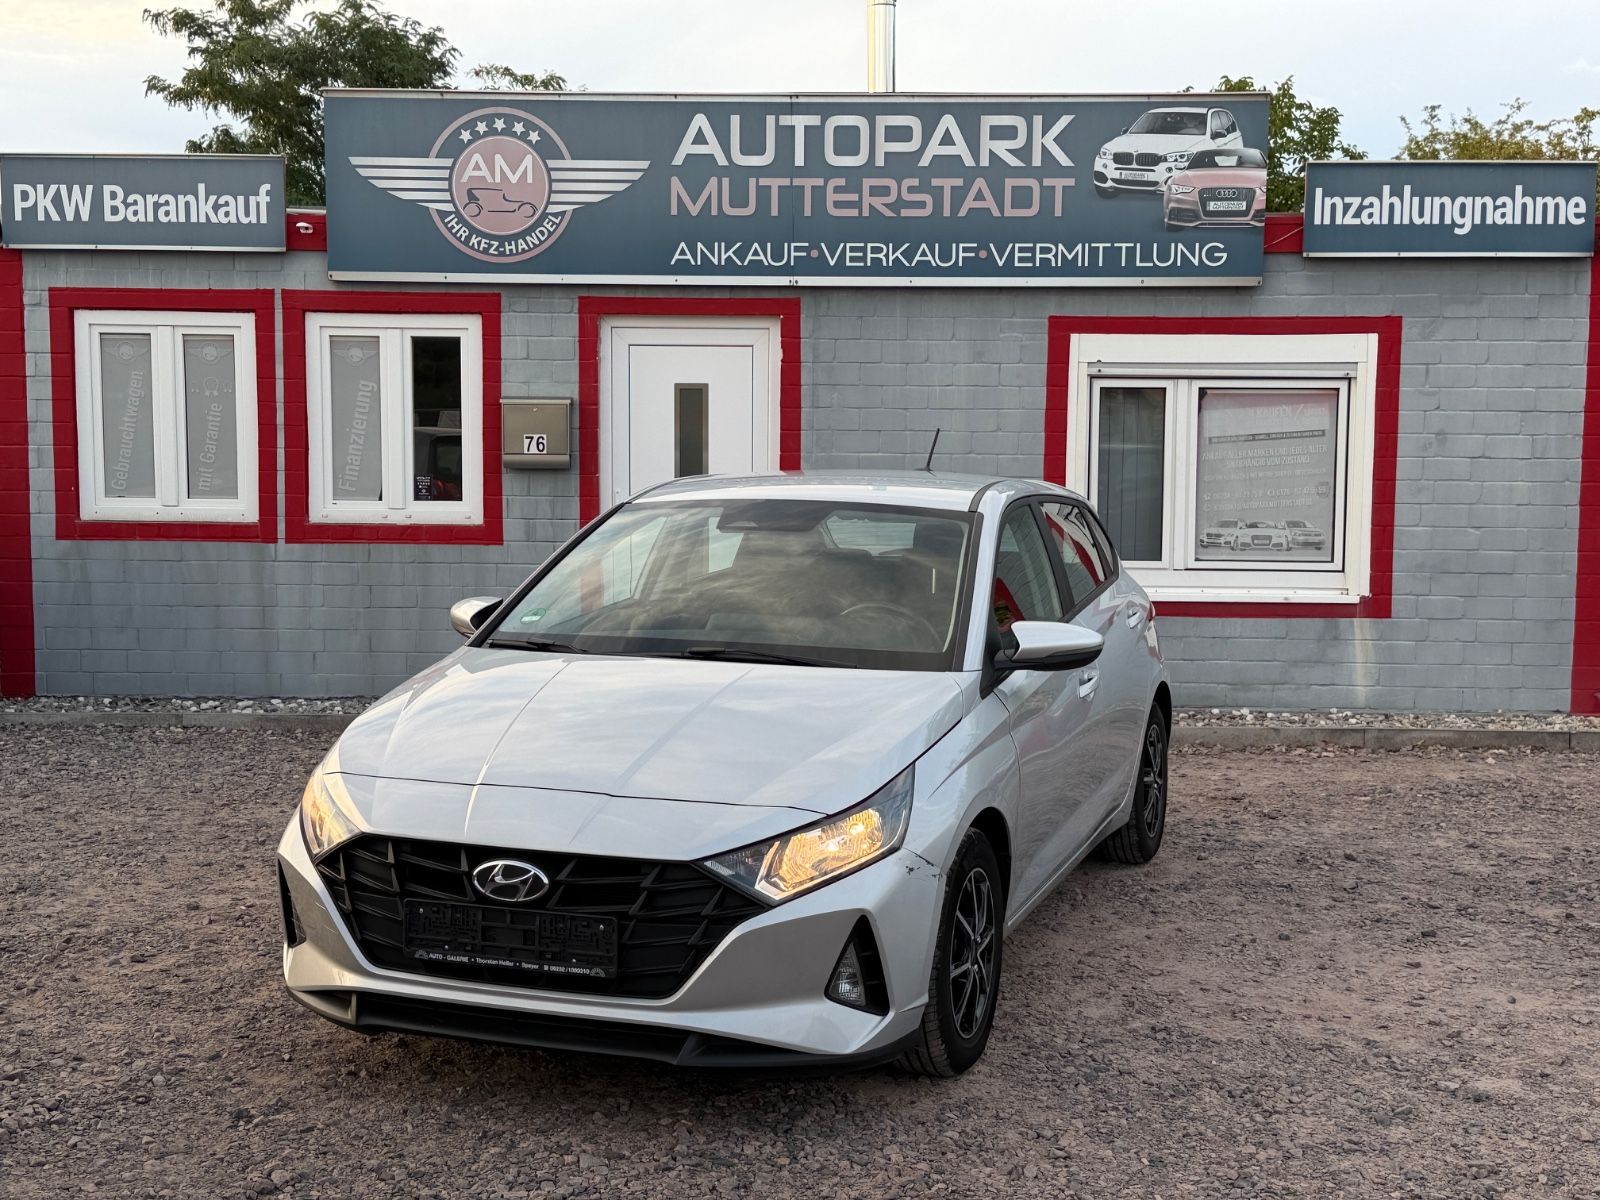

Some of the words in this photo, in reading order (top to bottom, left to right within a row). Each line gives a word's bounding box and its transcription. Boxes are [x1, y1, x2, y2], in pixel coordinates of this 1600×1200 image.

[670, 113, 1076, 167] AUTOPARK
[460, 153, 533, 184] AM
[13, 183, 94, 222] PKW
[102, 182, 271, 224] Barankauf
[670, 176, 1076, 217] MUTTERSTADT
[1313, 184, 1587, 235] Inzahlungnahme
[444, 214, 469, 241] IHR
[468, 215, 561, 255] KFZ-HANDEL
[989, 242, 1228, 267] VERMITTLUNG
[111, 370, 145, 491] Gebrauchtwagen
[199, 402, 223, 464] Garantie
[337, 379, 378, 492] Finanzierung
[524, 435, 546, 453] 76
[194, 465, 212, 491] mit
